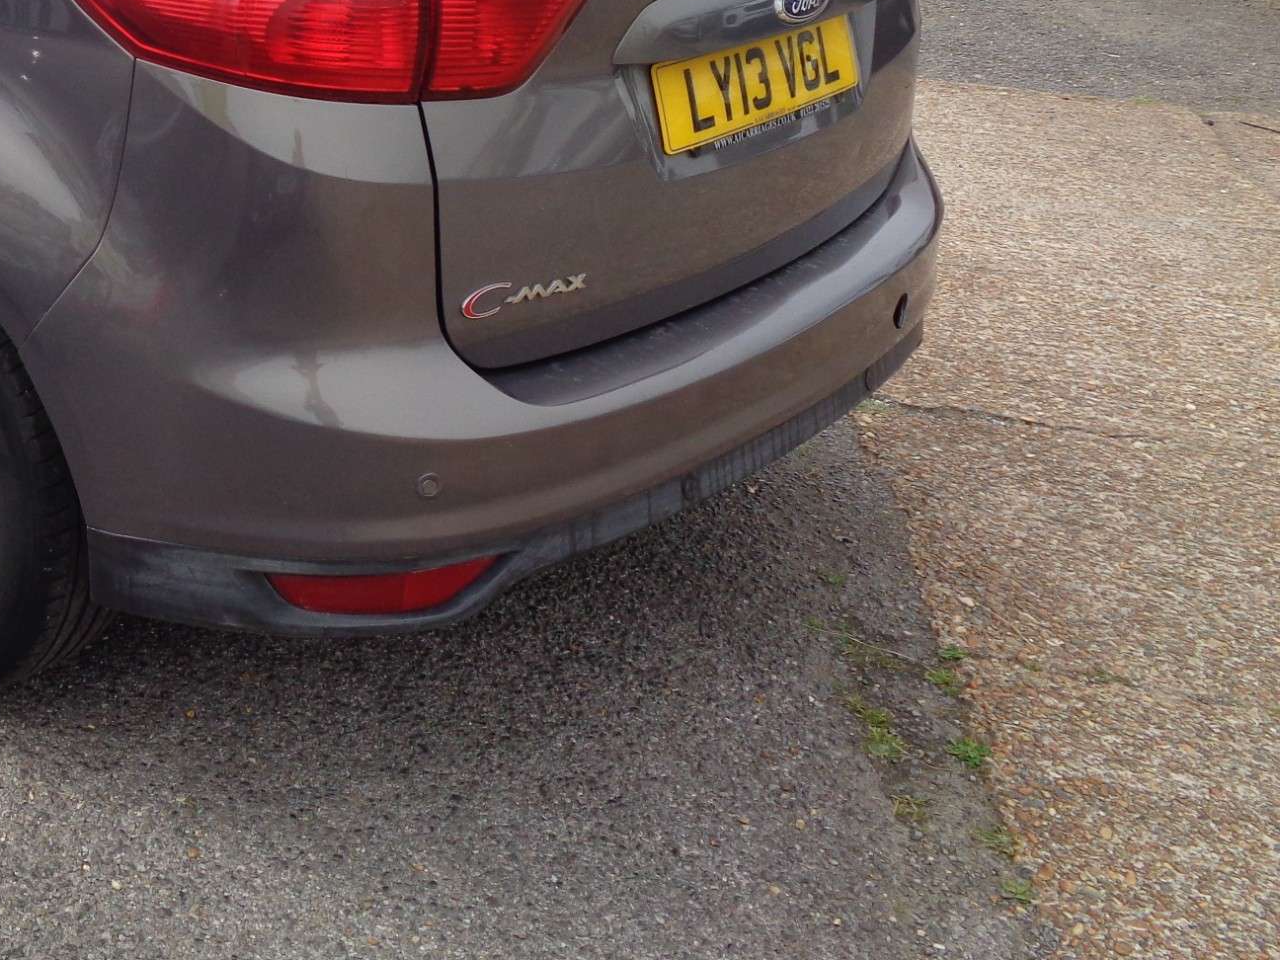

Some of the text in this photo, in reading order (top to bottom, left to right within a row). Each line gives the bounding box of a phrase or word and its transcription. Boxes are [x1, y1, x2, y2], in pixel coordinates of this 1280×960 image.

[683, 26, 840, 133] LY13 VGL
[462, 273, 587, 319] C-MAX
